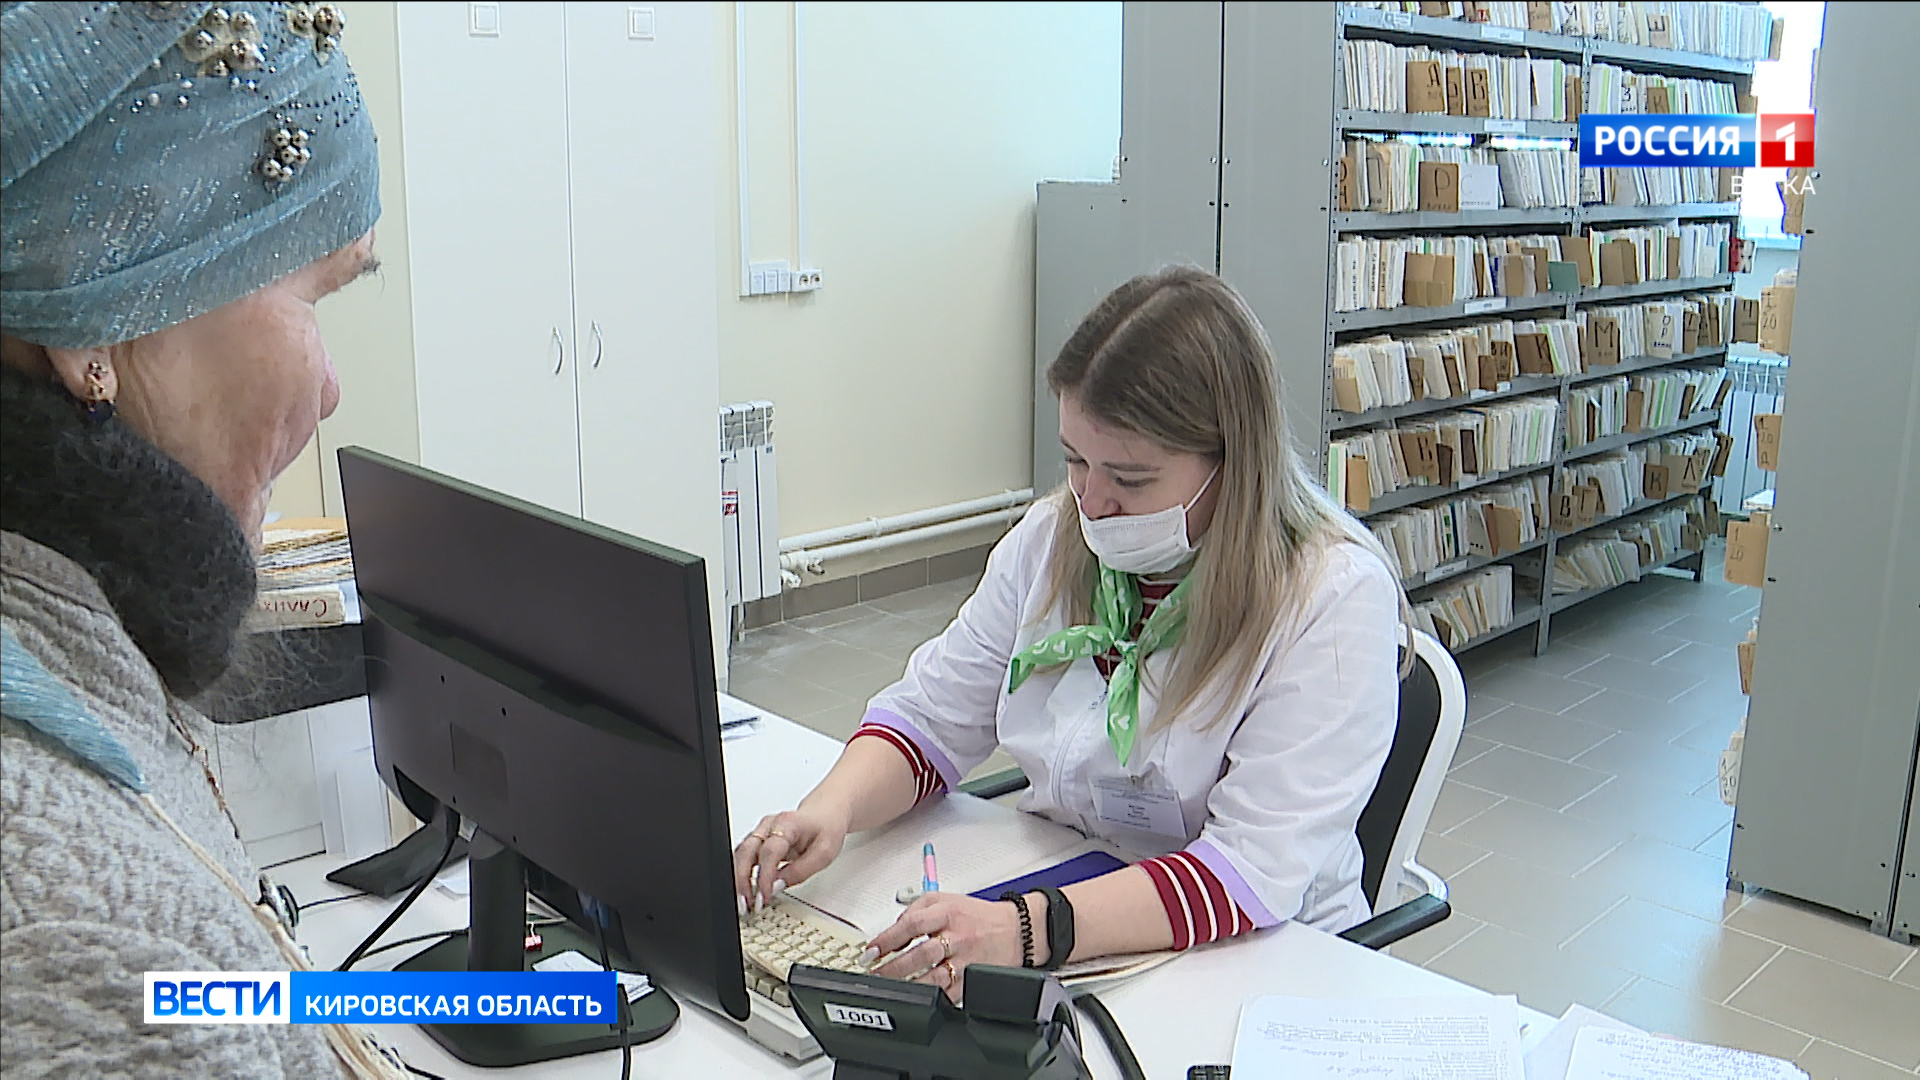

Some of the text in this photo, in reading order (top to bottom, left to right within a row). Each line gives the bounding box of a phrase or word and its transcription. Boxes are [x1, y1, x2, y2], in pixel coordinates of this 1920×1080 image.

[1434, 167, 1450, 198] Р
[1594, 320, 1614, 348] М
[836, 1009, 887, 1026] 1001
